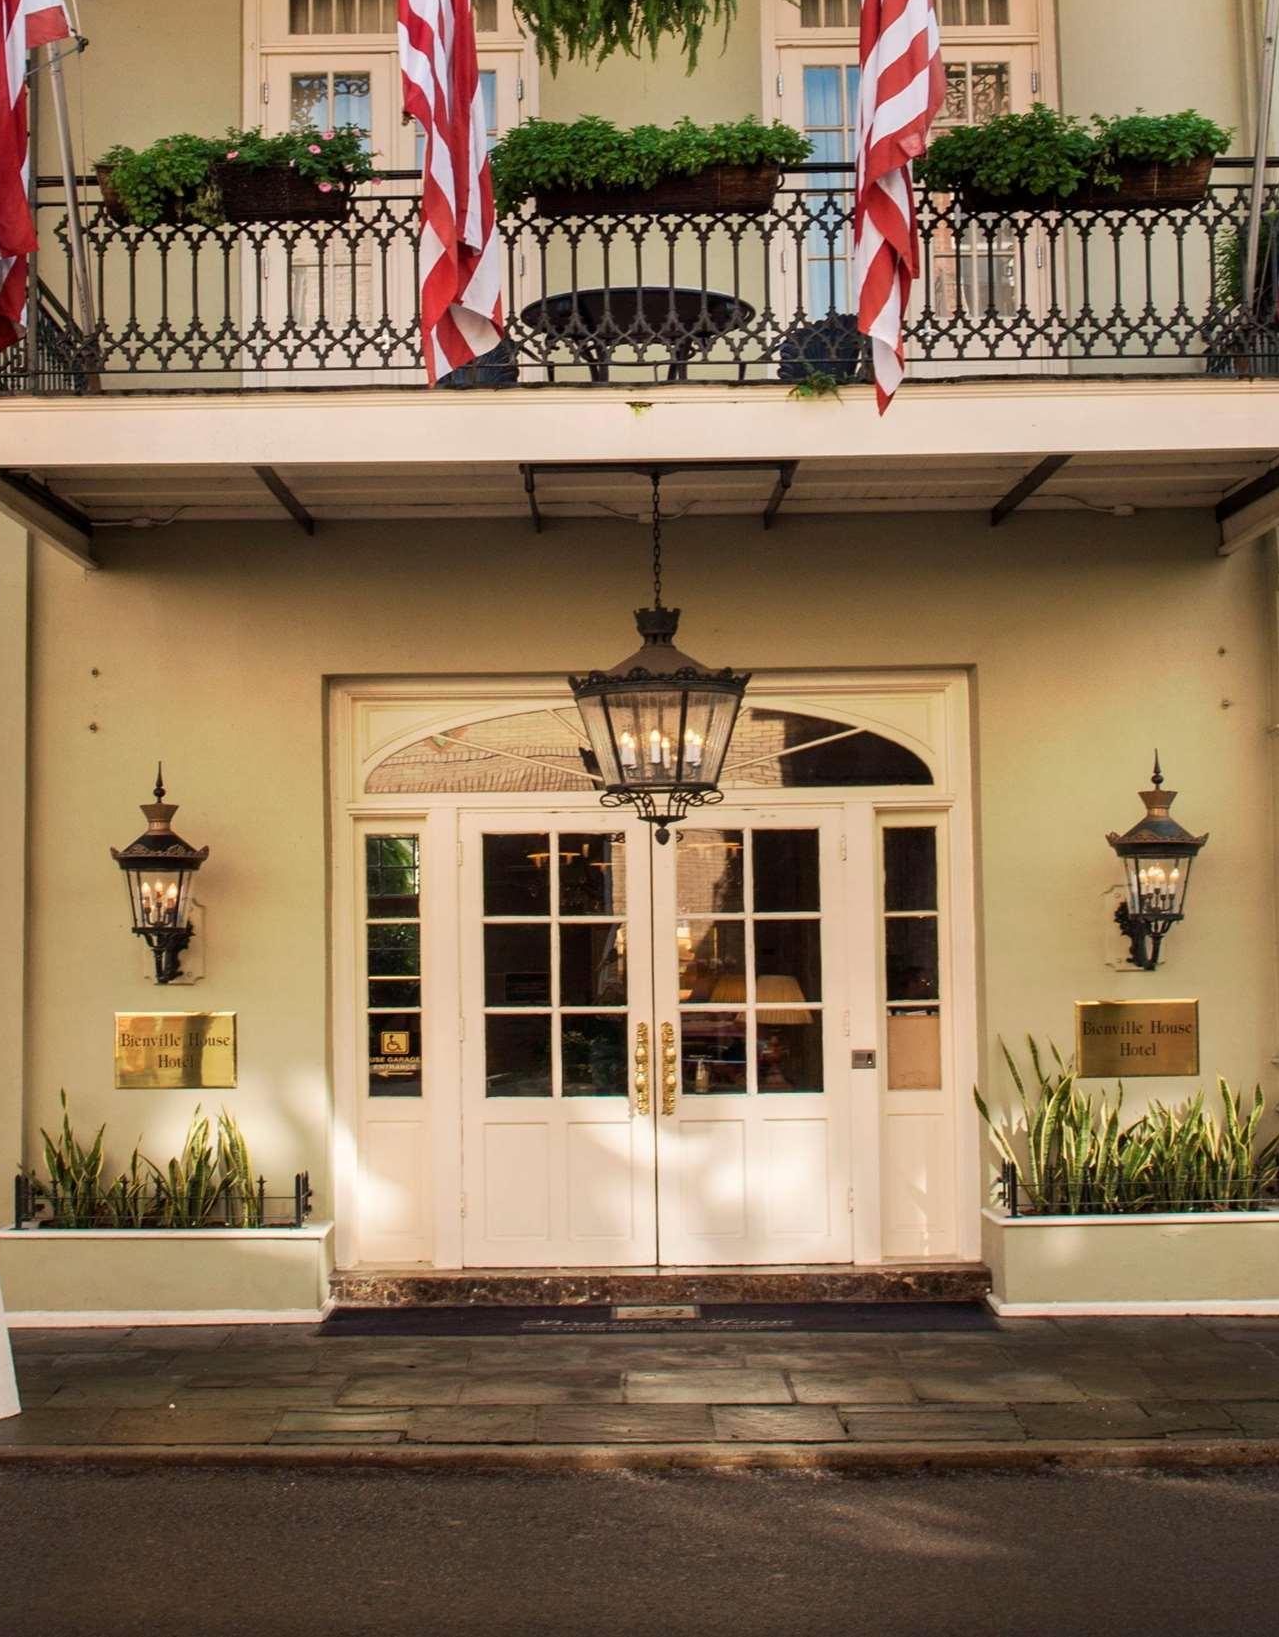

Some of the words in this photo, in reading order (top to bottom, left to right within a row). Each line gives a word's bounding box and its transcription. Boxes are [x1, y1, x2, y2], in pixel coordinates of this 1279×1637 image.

[1082, 1021, 1143, 1036] Bienville
[1150, 1020, 1192, 1035] House
[120, 1033, 181, 1047] Bienville
[189, 1032, 231, 1047] House
[1120, 1042, 1157, 1057] Hotel
[158, 1054, 194, 1068] Hotel
[387, 1056, 420, 1064] GARAGE
